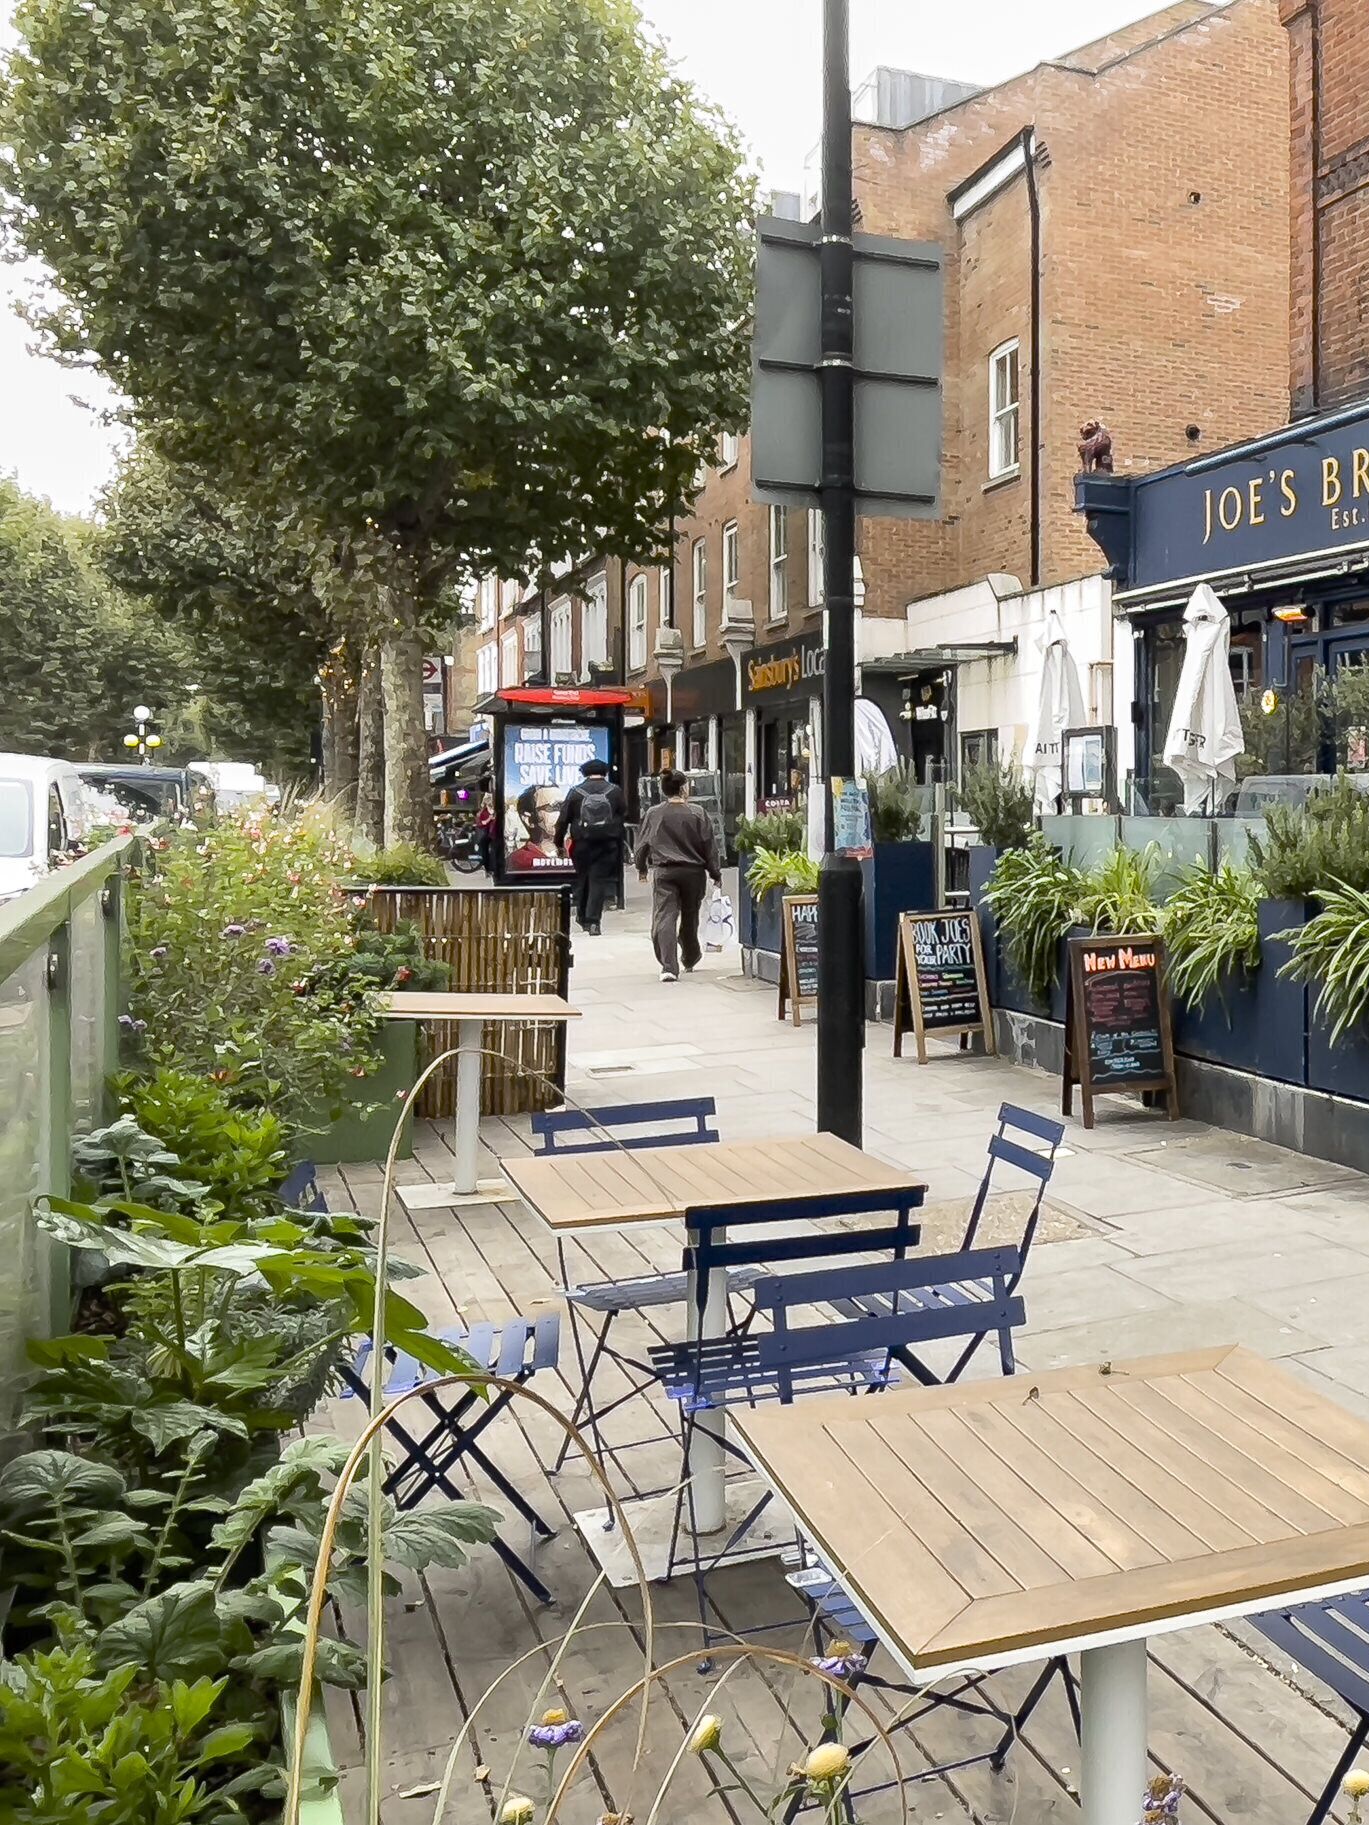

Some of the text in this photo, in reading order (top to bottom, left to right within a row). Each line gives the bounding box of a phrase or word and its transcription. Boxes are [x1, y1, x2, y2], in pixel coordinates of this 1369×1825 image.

[1201, 468, 1298, 545] JOE'S
[801, 644, 826, 679] Loca
[514, 743, 596, 764] RAISE FUNDS
[519, 765, 585, 786] SAVE LIVE
[911, 917, 971, 945] BOOK JOES
[935, 943, 972, 966] PARTY
